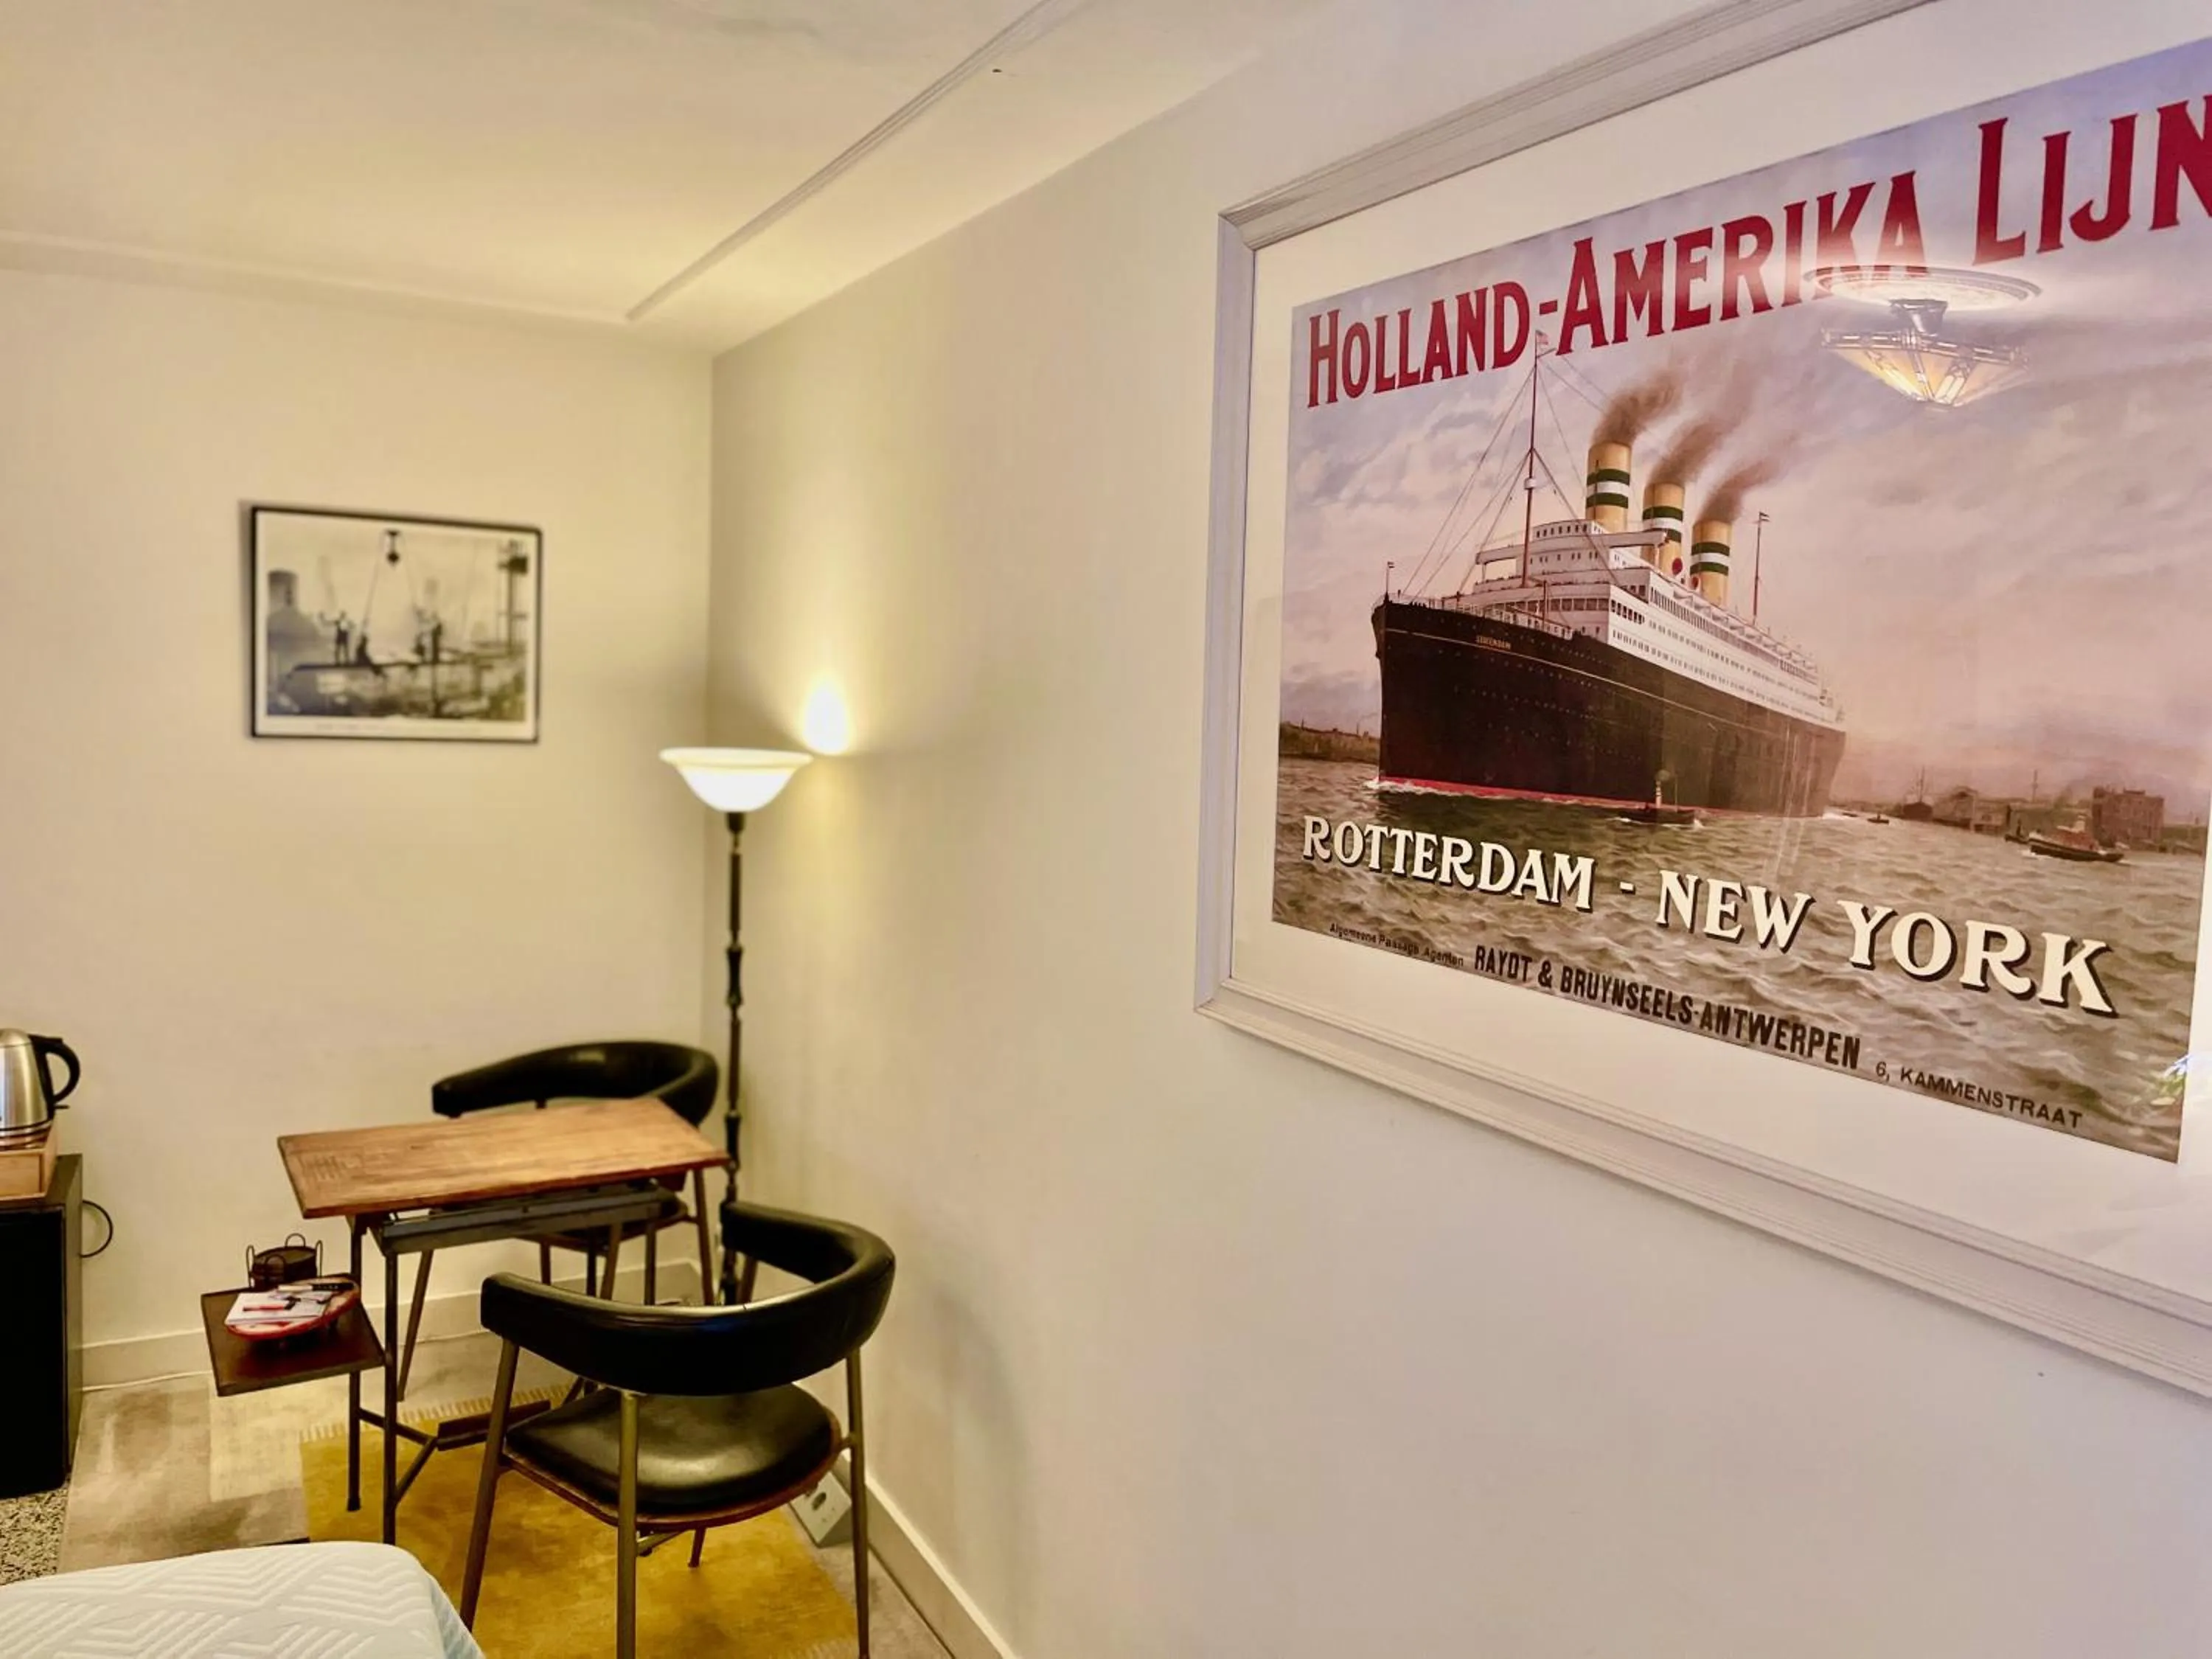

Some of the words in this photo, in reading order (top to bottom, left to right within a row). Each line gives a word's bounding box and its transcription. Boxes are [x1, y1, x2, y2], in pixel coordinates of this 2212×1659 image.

[1972, 94, 2212, 265] LIJN
[1303, 815, 1597, 913] ROTTERDAM
[1655, 870, 1815, 953] NEW
[1837, 900, 2118, 1018] YORK
[1537, 960, 1553, 989] &
[1875, 1061, 1890, 1082] 6,
[1900, 1067, 2082, 1128] KAMMENSTRAAT
